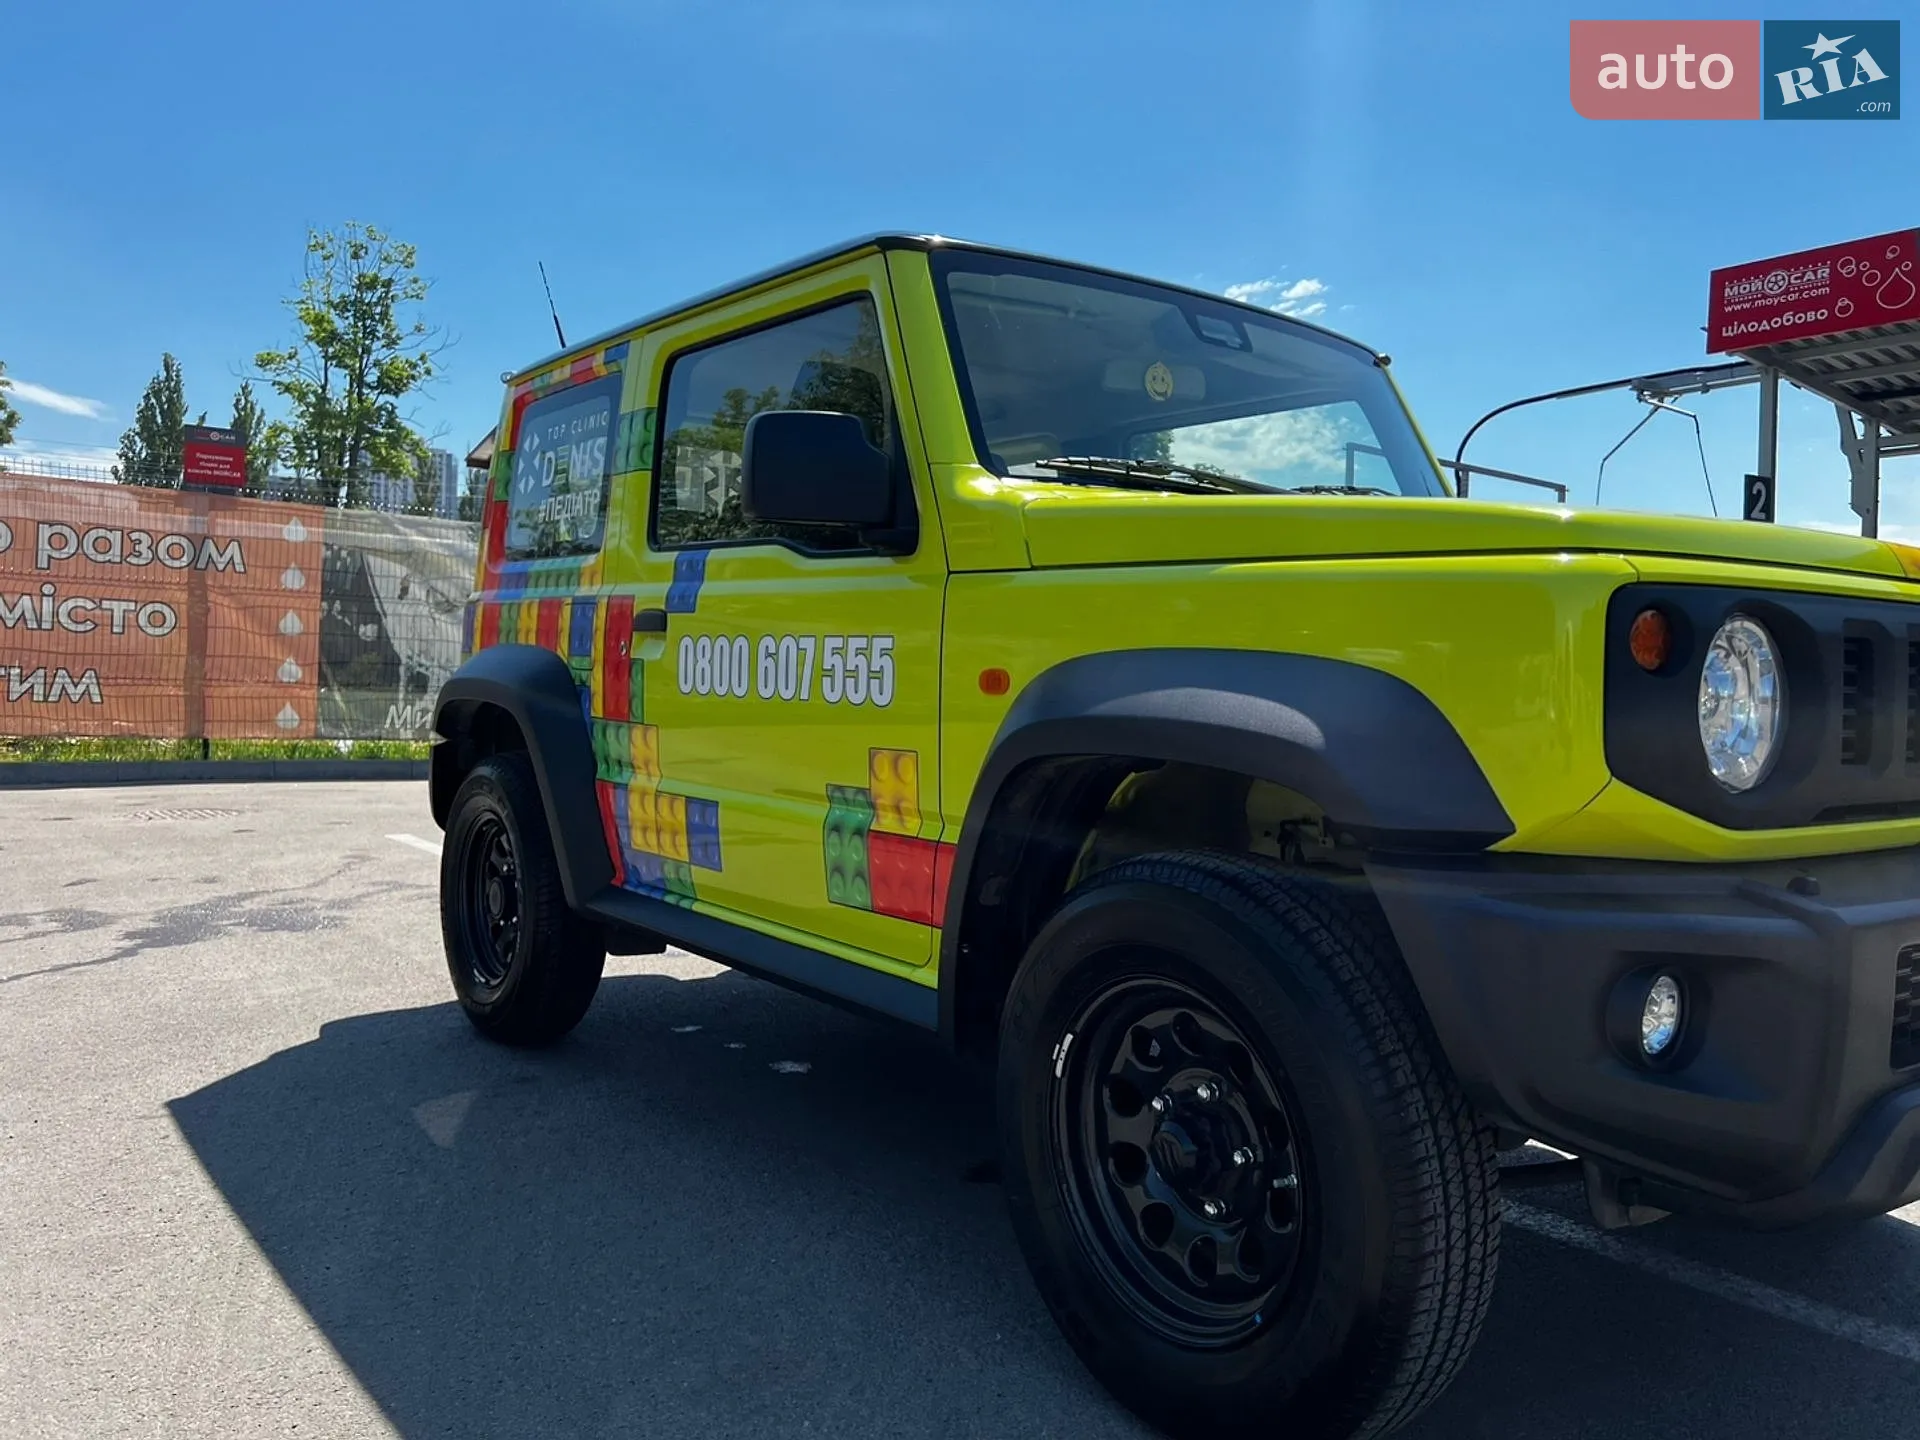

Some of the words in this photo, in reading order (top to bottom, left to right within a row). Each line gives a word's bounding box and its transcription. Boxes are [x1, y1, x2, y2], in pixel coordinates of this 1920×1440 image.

[1790, 268, 1830, 283] CAR
[1724, 286, 1830, 313] www.moycar.com
[547, 424, 566, 441] TOP
[571, 411, 608, 434] CLINIC
[1750, 481, 1766, 520] 2
[36, 521, 247, 574] разом
[0, 582, 177, 637] місто
[0, 666, 103, 704] им
[678, 634, 750, 698] 0800
[757, 634, 816, 701] 607
[822, 634, 895, 707] 555
